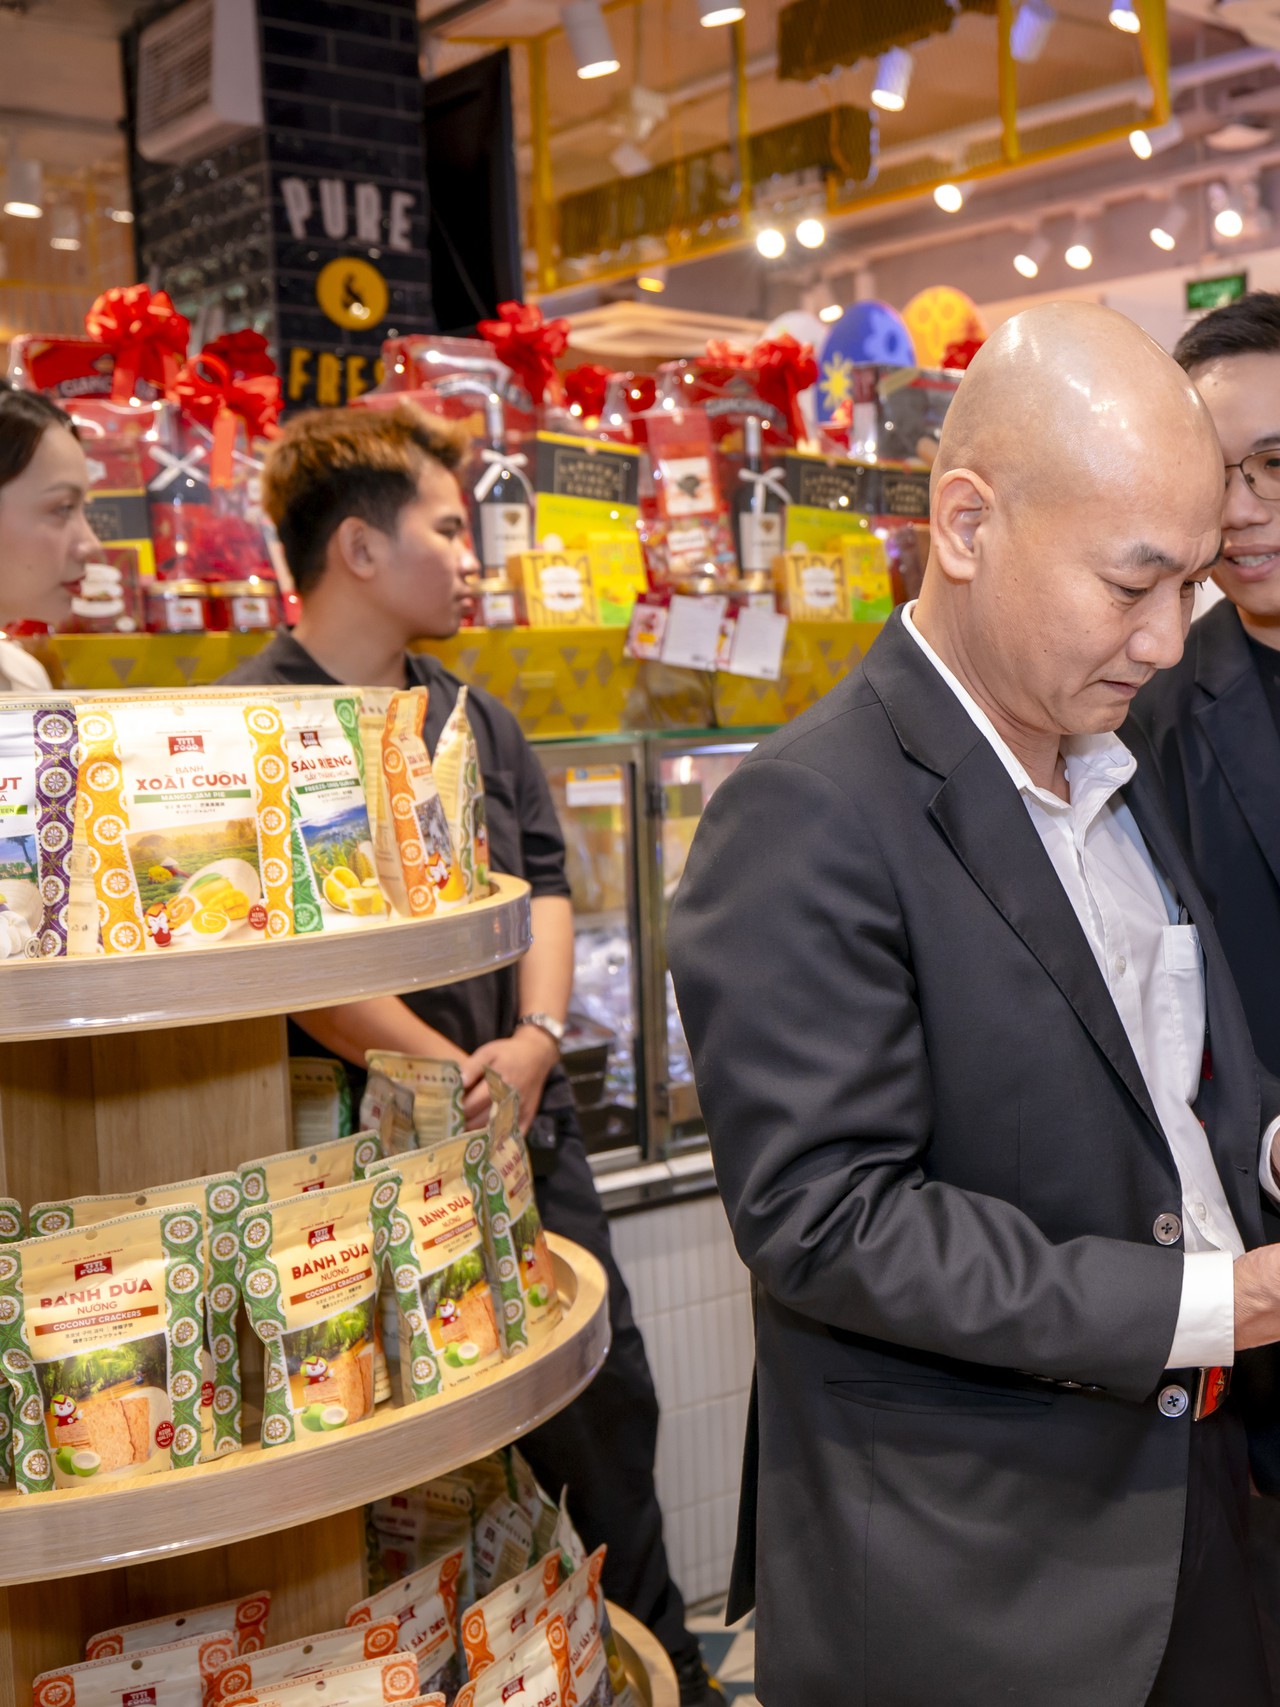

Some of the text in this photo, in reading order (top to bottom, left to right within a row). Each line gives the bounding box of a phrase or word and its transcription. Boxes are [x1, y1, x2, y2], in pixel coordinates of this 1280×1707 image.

[281, 176, 416, 250] PURE
[161, 790, 227, 802] MANGO JAM PIE
[80, 1265, 107, 1276] FOOD
[83, 1260, 103, 1270] TITI
[291, 1253, 338, 1281] BÁNH
[40, 1277, 153, 1310] BÁNH DỪA
[304, 1283, 338, 1300] COCONUT
[53, 1309, 142, 1331] COCONUT CRACKERS
